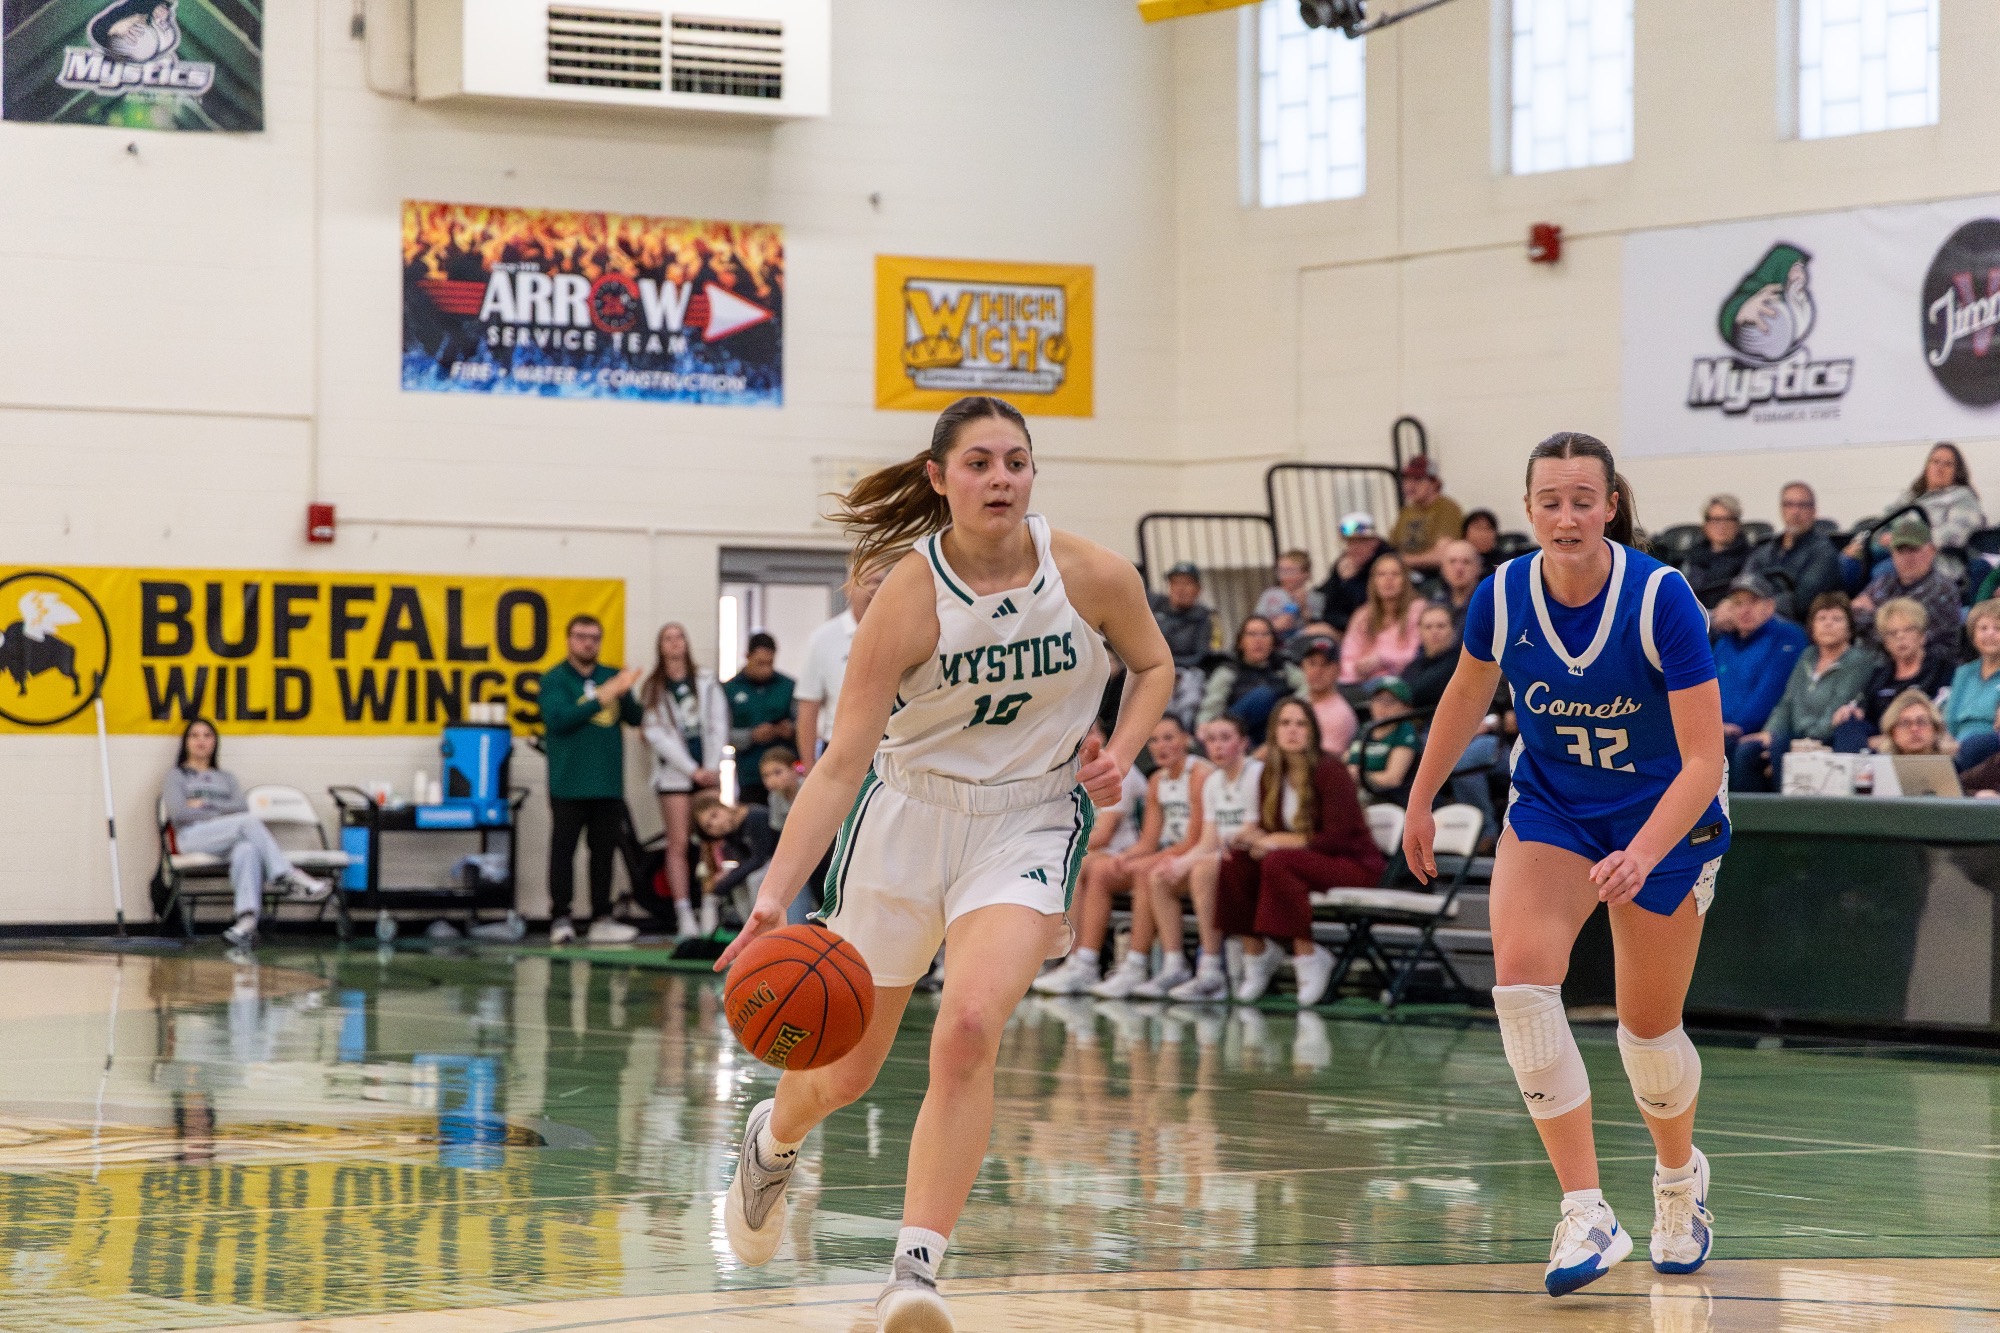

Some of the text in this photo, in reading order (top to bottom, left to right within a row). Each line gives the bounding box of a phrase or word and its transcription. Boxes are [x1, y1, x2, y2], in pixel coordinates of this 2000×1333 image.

[65, 51, 210, 88] Mystics
[479, 268, 694, 333] ARROW
[486, 325, 689, 354] SERVICE TEAM
[1688, 352, 1853, 414] Mystics
[140, 580, 550, 663] BUFFALO
[937, 632, 1077, 690] MYSTICS
[143, 664, 541, 724] WILD WINGS
[1524, 681, 1642, 719] Comets
[1555, 726, 1636, 773] 32
